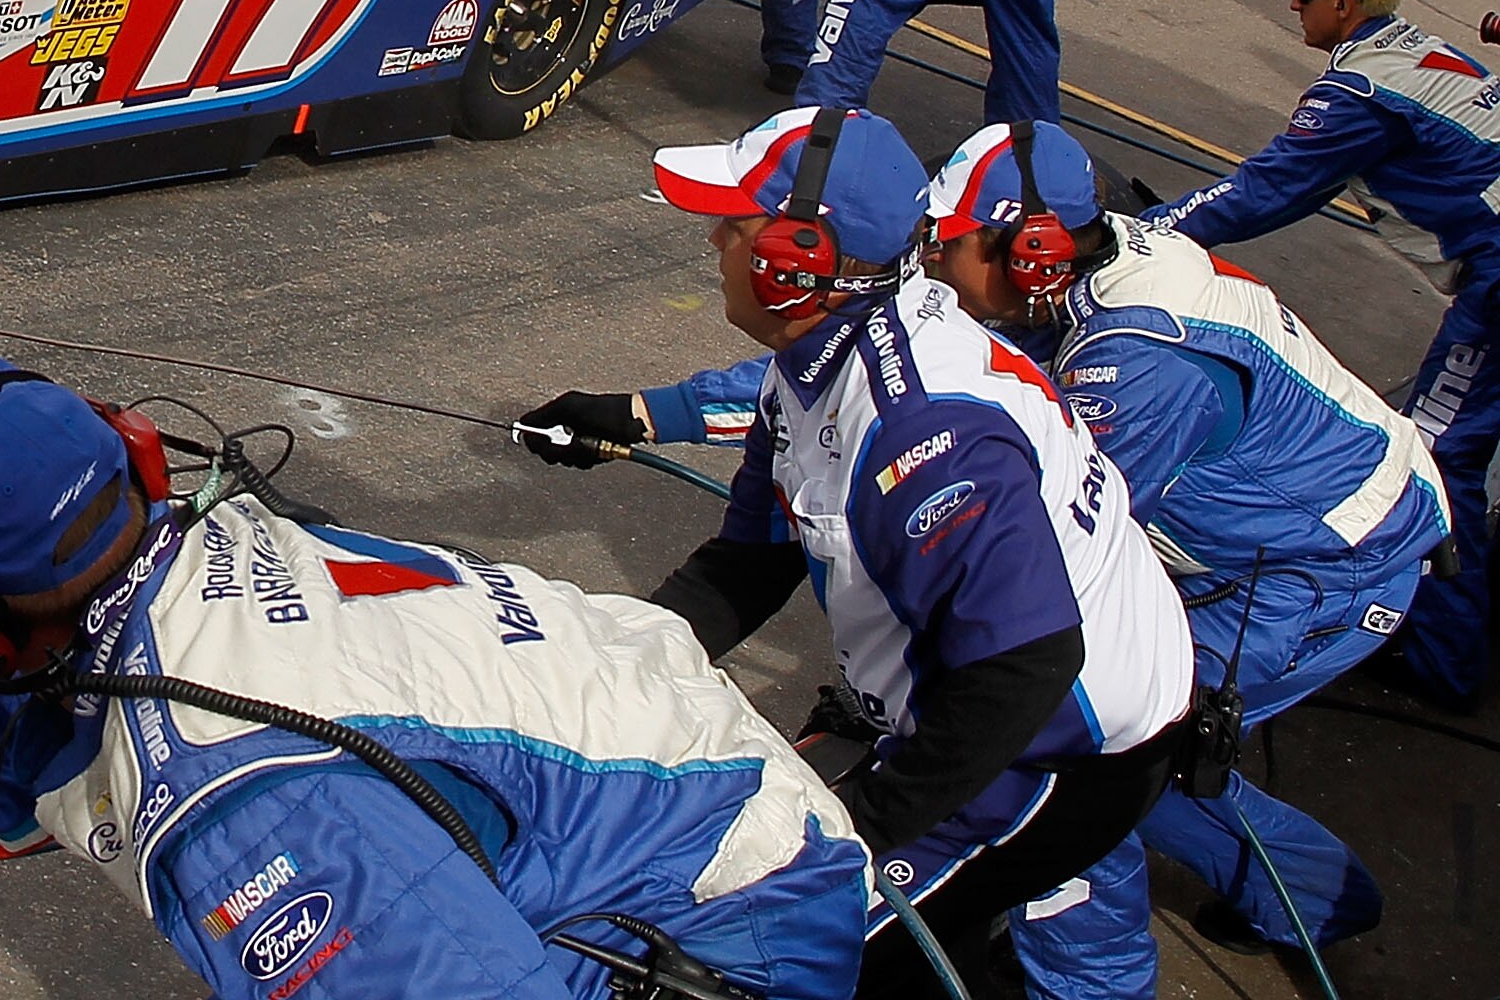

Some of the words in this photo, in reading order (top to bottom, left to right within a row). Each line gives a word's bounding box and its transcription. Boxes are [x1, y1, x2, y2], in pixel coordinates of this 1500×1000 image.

[73, 4, 125, 22] Meter
[433, 26, 470, 41] TOOLS
[435, 0, 474, 31] MAC
[30, 24, 120, 65] JEGS
[988, 199, 1024, 223] 17
[798, 322, 854, 385] Valvoline
[1073, 365, 1118, 384] NASCAR
[894, 429, 956, 480] NASCAR
[916, 490, 963, 533] Ford
[86, 577, 132, 634] Crown
[120, 523, 173, 606] Royal
[221, 853, 299, 927] NASCAR
[252, 905, 319, 974] Ford
